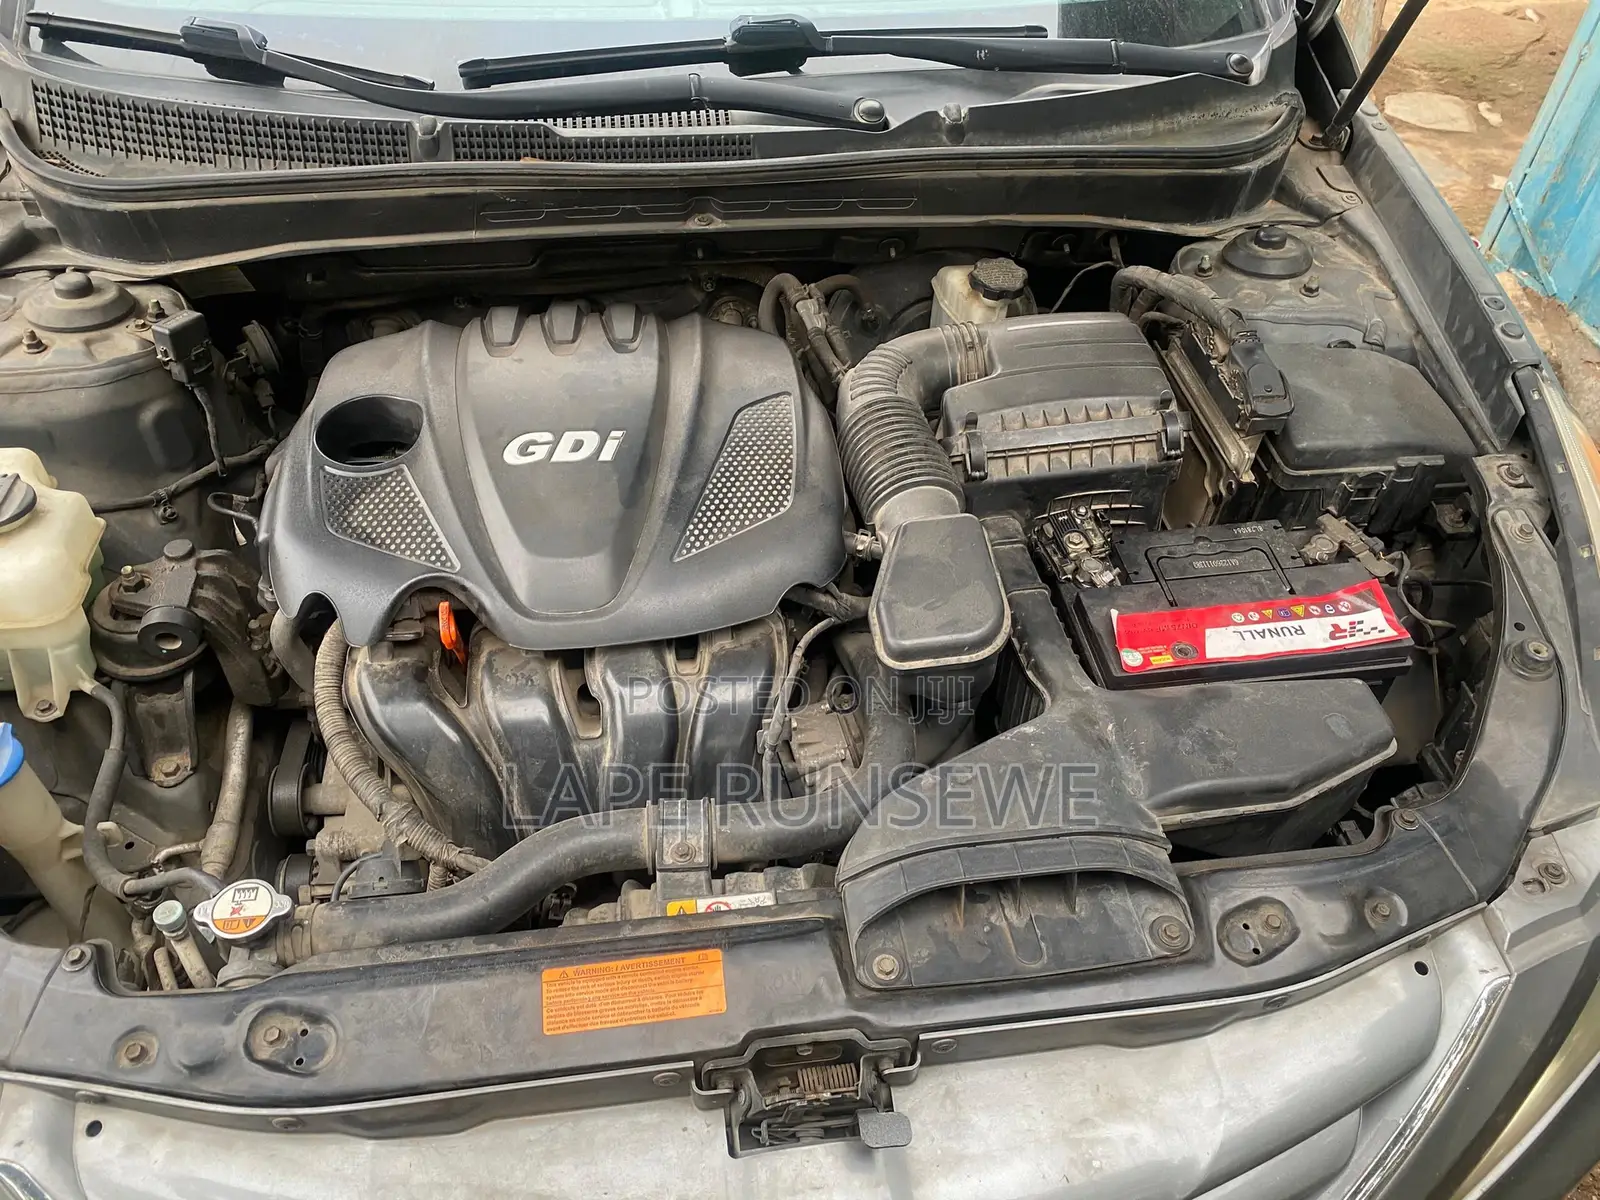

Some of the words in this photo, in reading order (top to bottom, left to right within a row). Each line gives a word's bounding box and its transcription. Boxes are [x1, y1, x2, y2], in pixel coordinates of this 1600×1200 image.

[502, 430, 627, 466] GDi
[1232, 624, 1305, 641] RUNALL
[572, 965, 613, 976] WARNING:
[620, 957, 685, 971] AVERTISSEMENT
